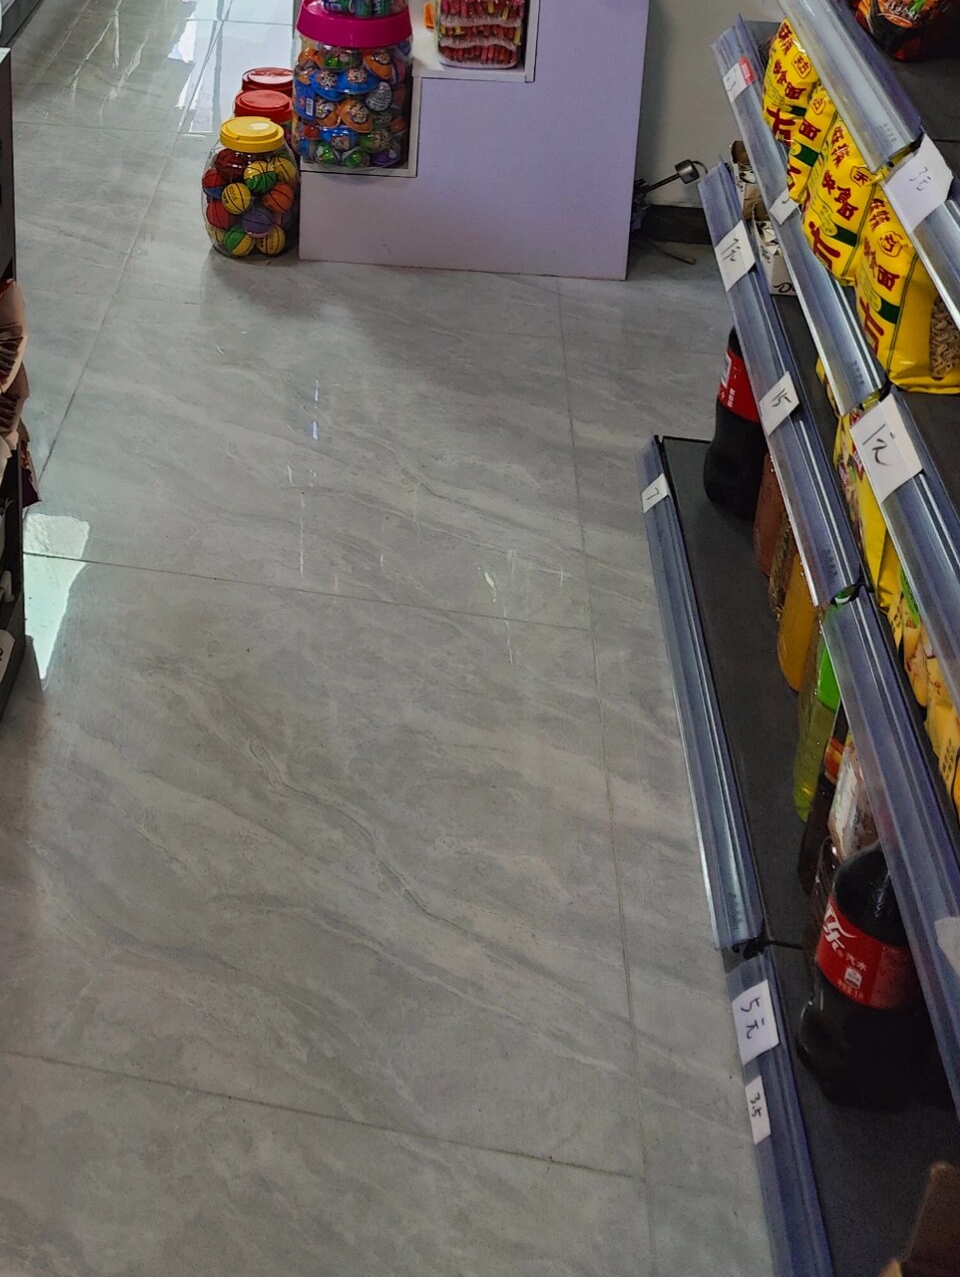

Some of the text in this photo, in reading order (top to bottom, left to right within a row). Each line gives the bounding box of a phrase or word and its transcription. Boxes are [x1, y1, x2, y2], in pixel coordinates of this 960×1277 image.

[822, 170, 859, 221] 快食面
[740, 995, 765, 1041] 5元
